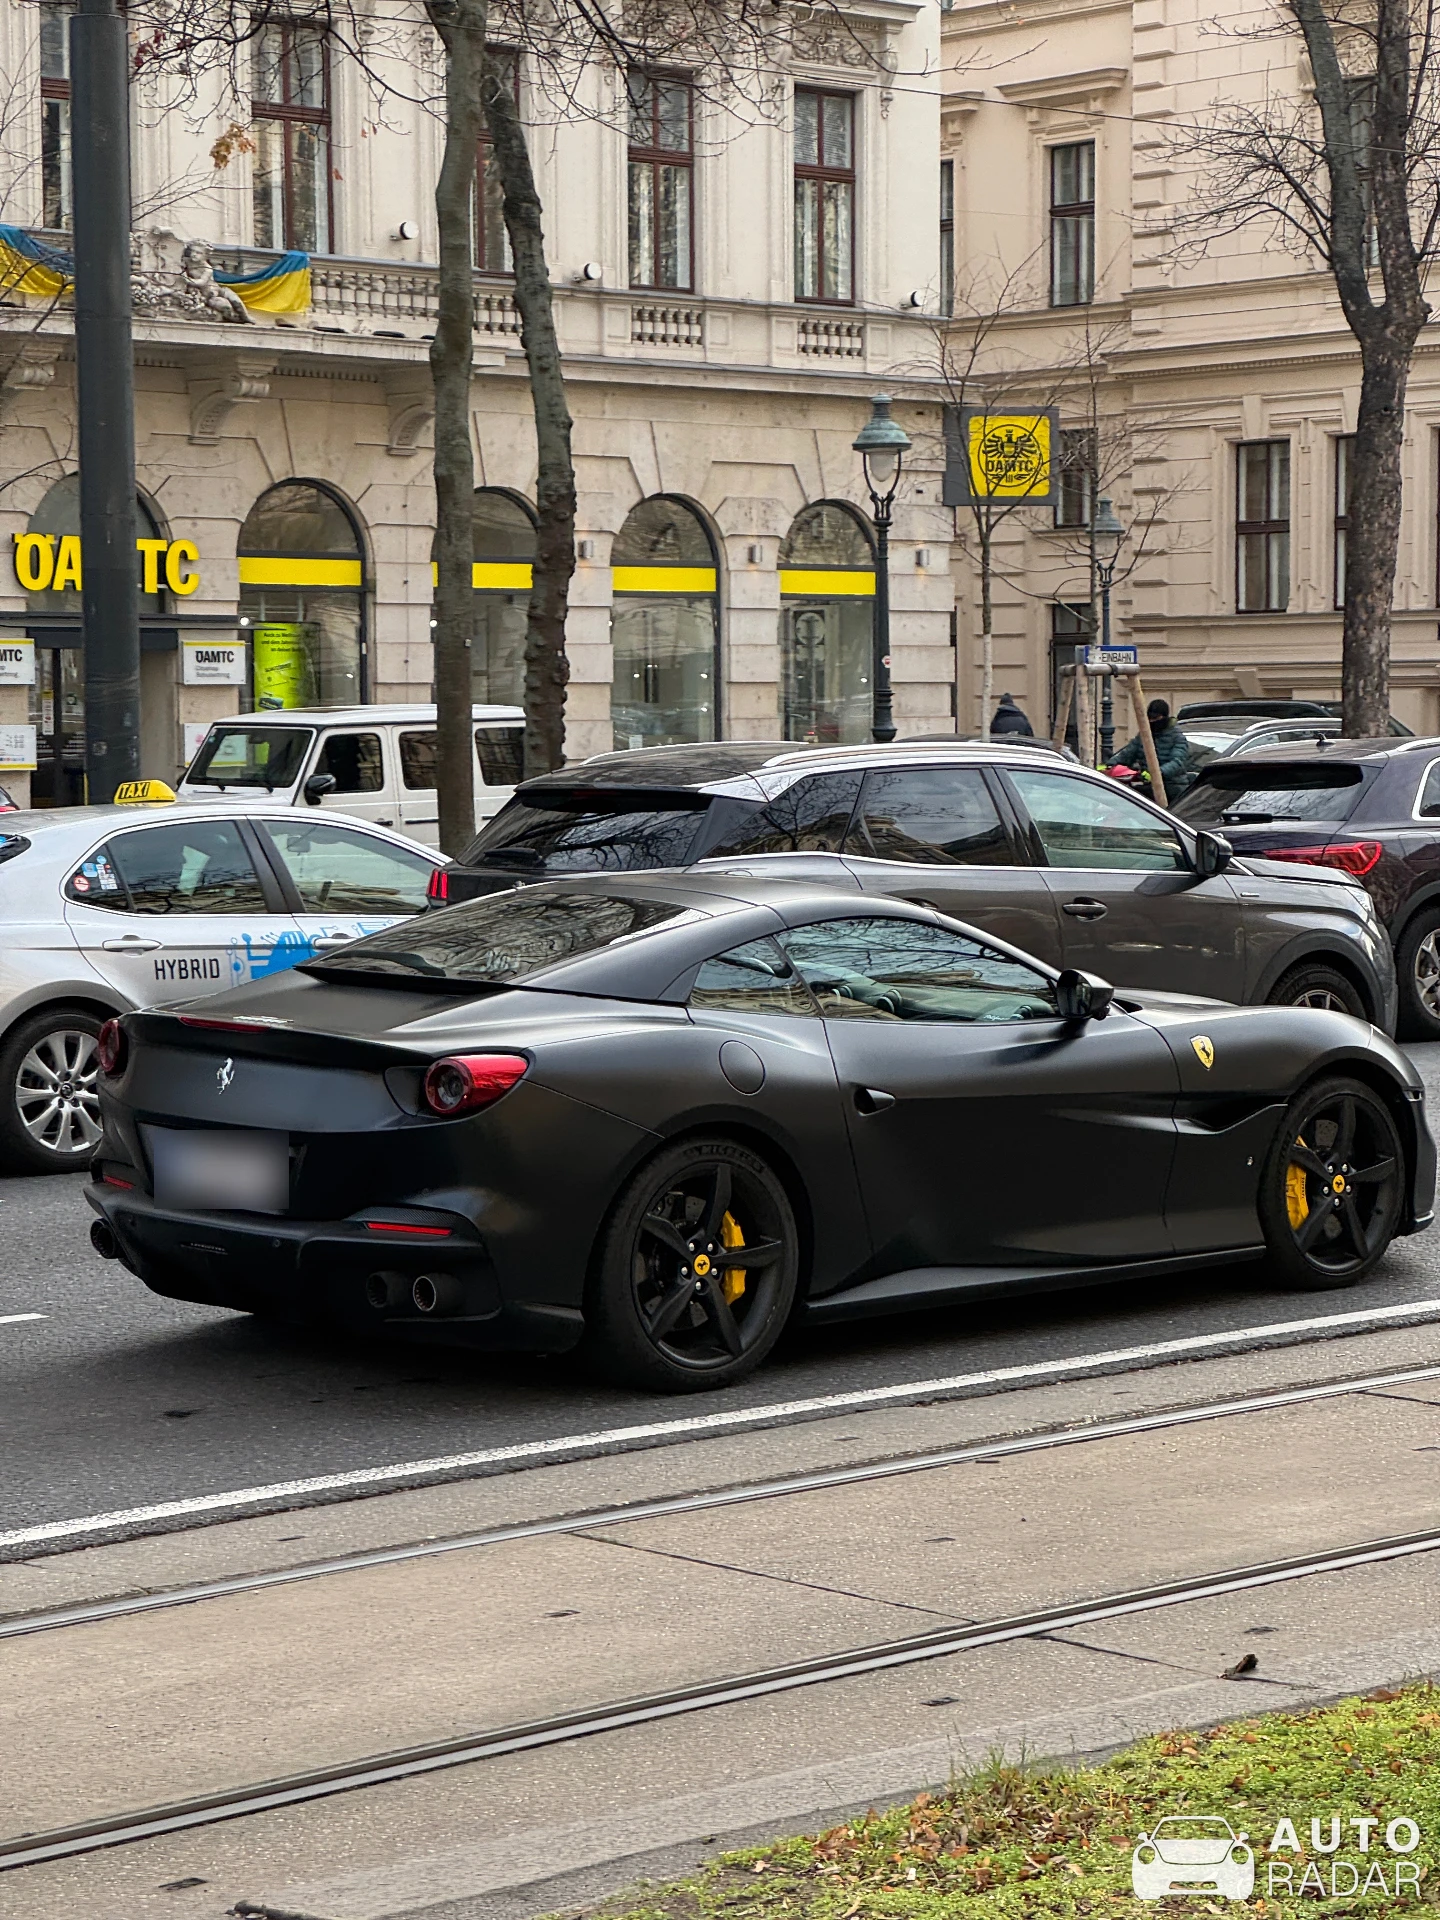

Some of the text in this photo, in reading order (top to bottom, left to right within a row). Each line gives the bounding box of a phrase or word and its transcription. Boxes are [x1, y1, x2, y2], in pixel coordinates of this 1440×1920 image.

[13, 532, 200, 595] ÖATC
[195, 650, 235, 663] ÖAMTC
[1101, 652, 1132, 663] EINBAHN
[119, 782, 150, 799] TAXI
[154, 957, 220, 981] HYBRID
